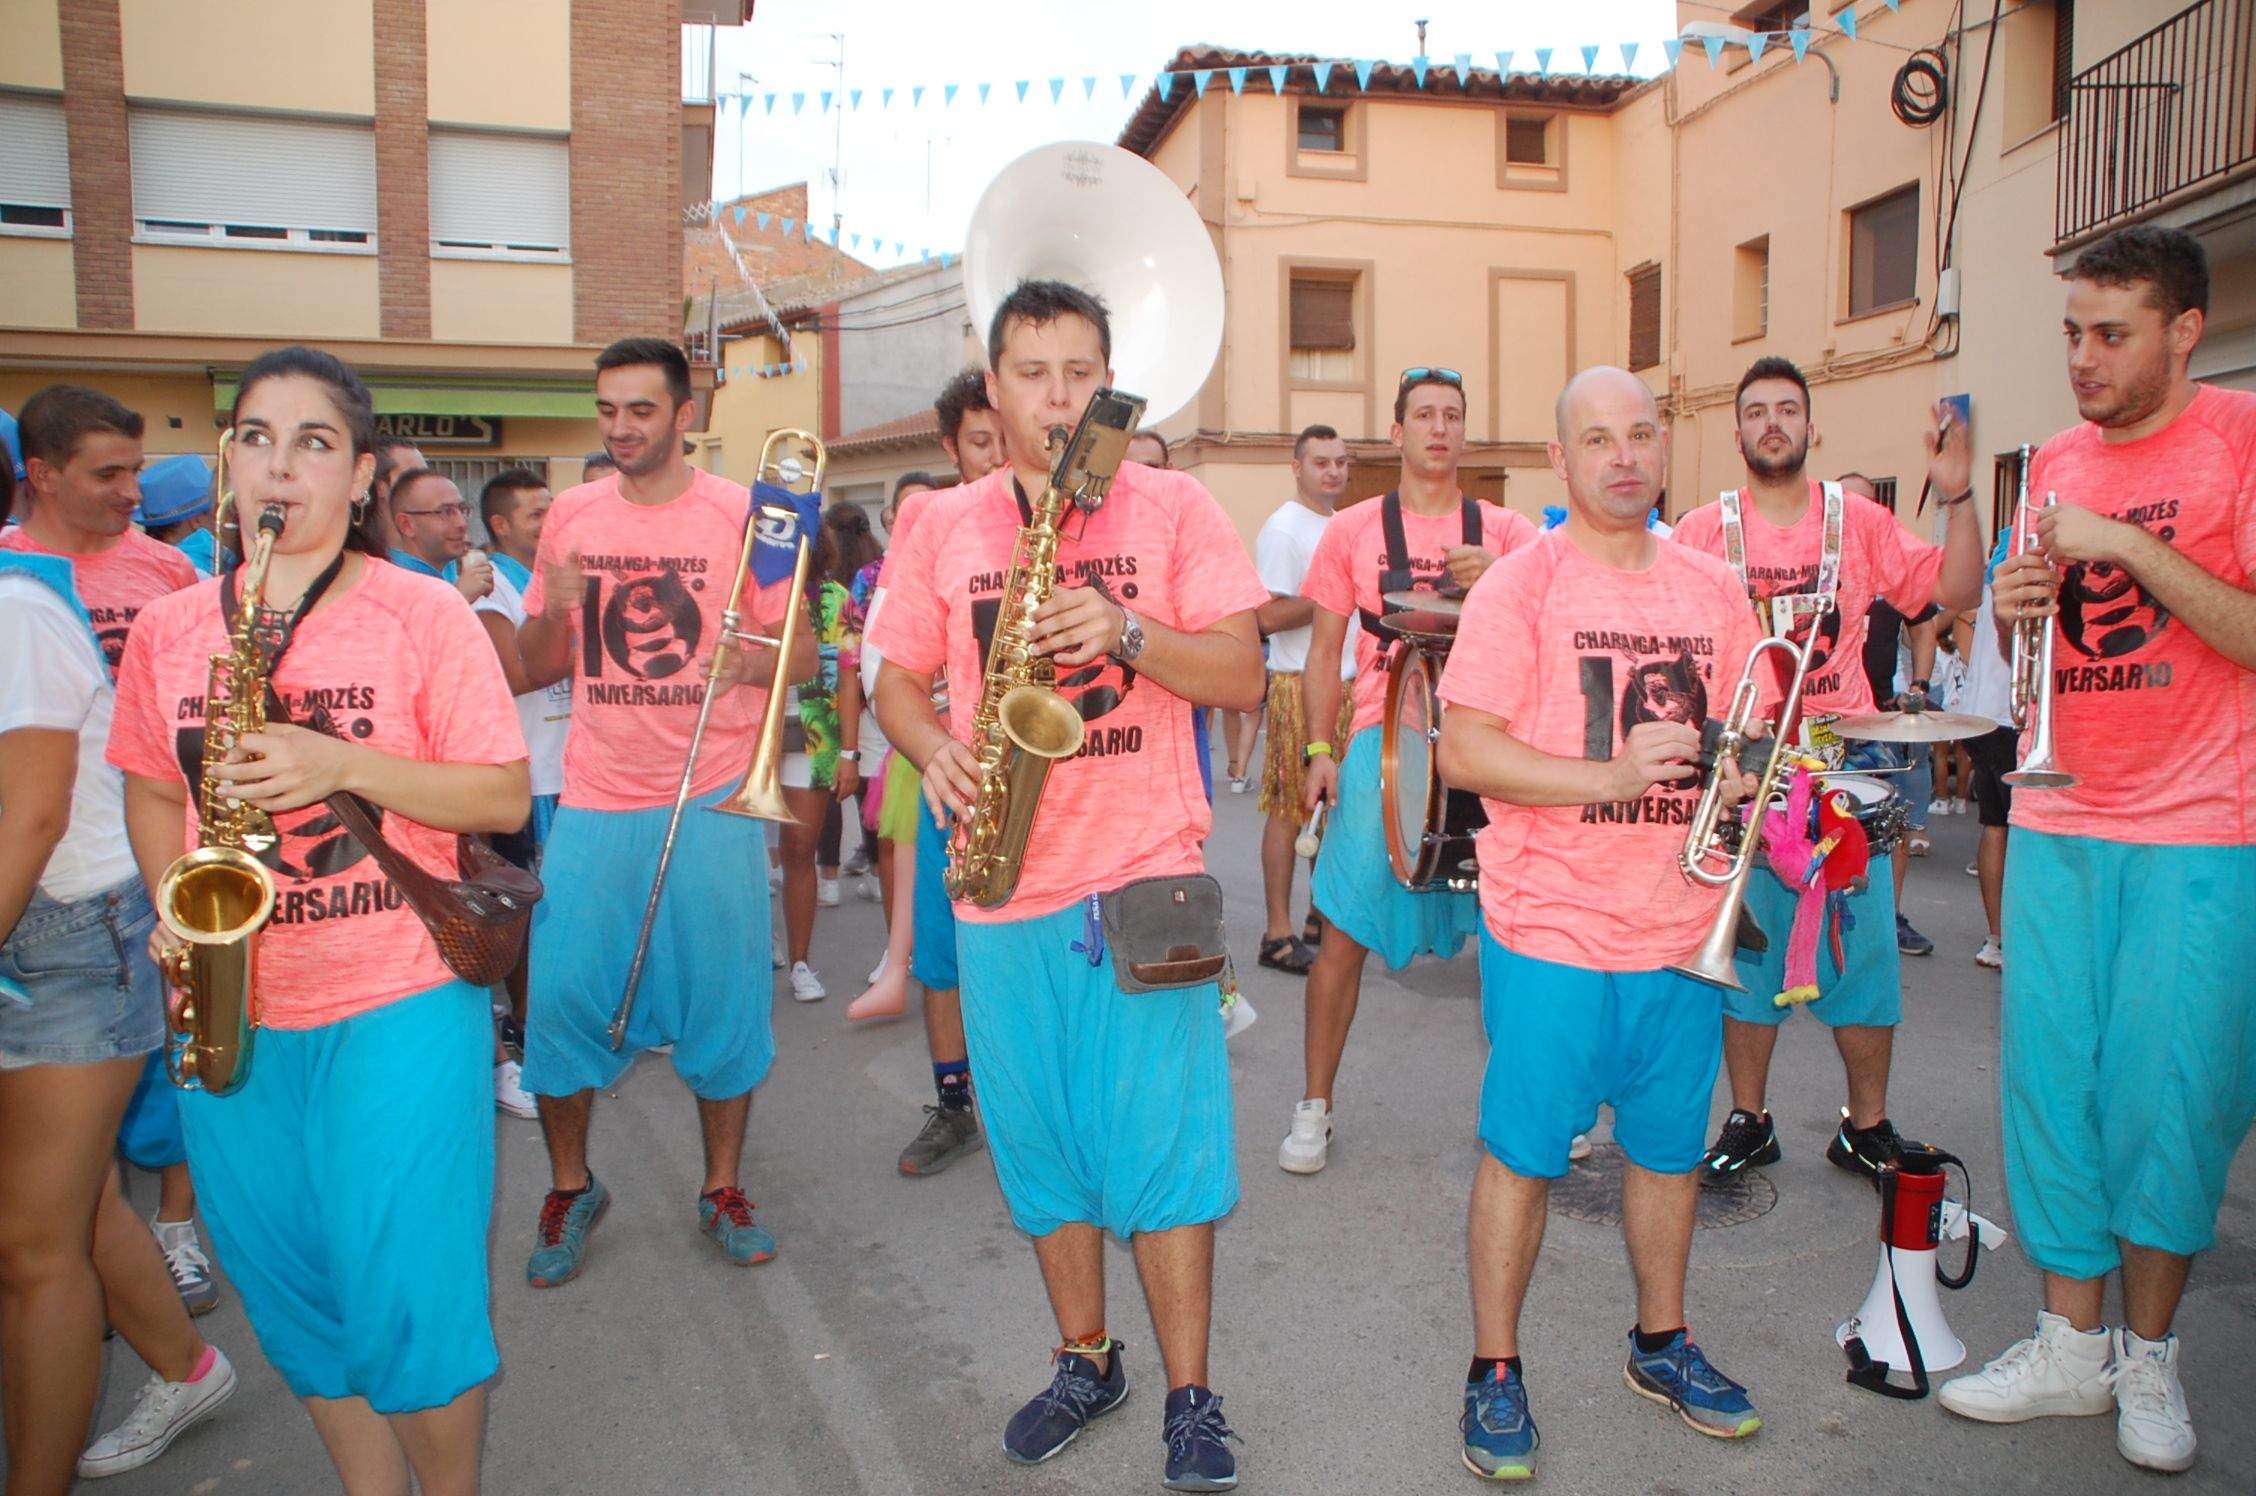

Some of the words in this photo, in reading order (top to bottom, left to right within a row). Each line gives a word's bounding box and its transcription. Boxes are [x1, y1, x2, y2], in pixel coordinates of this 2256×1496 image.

[375, 414, 493, 443] ARLO'S
[2055, 660, 2173, 694] VERSARIO
[269, 879, 402, 925] ERSARIO
